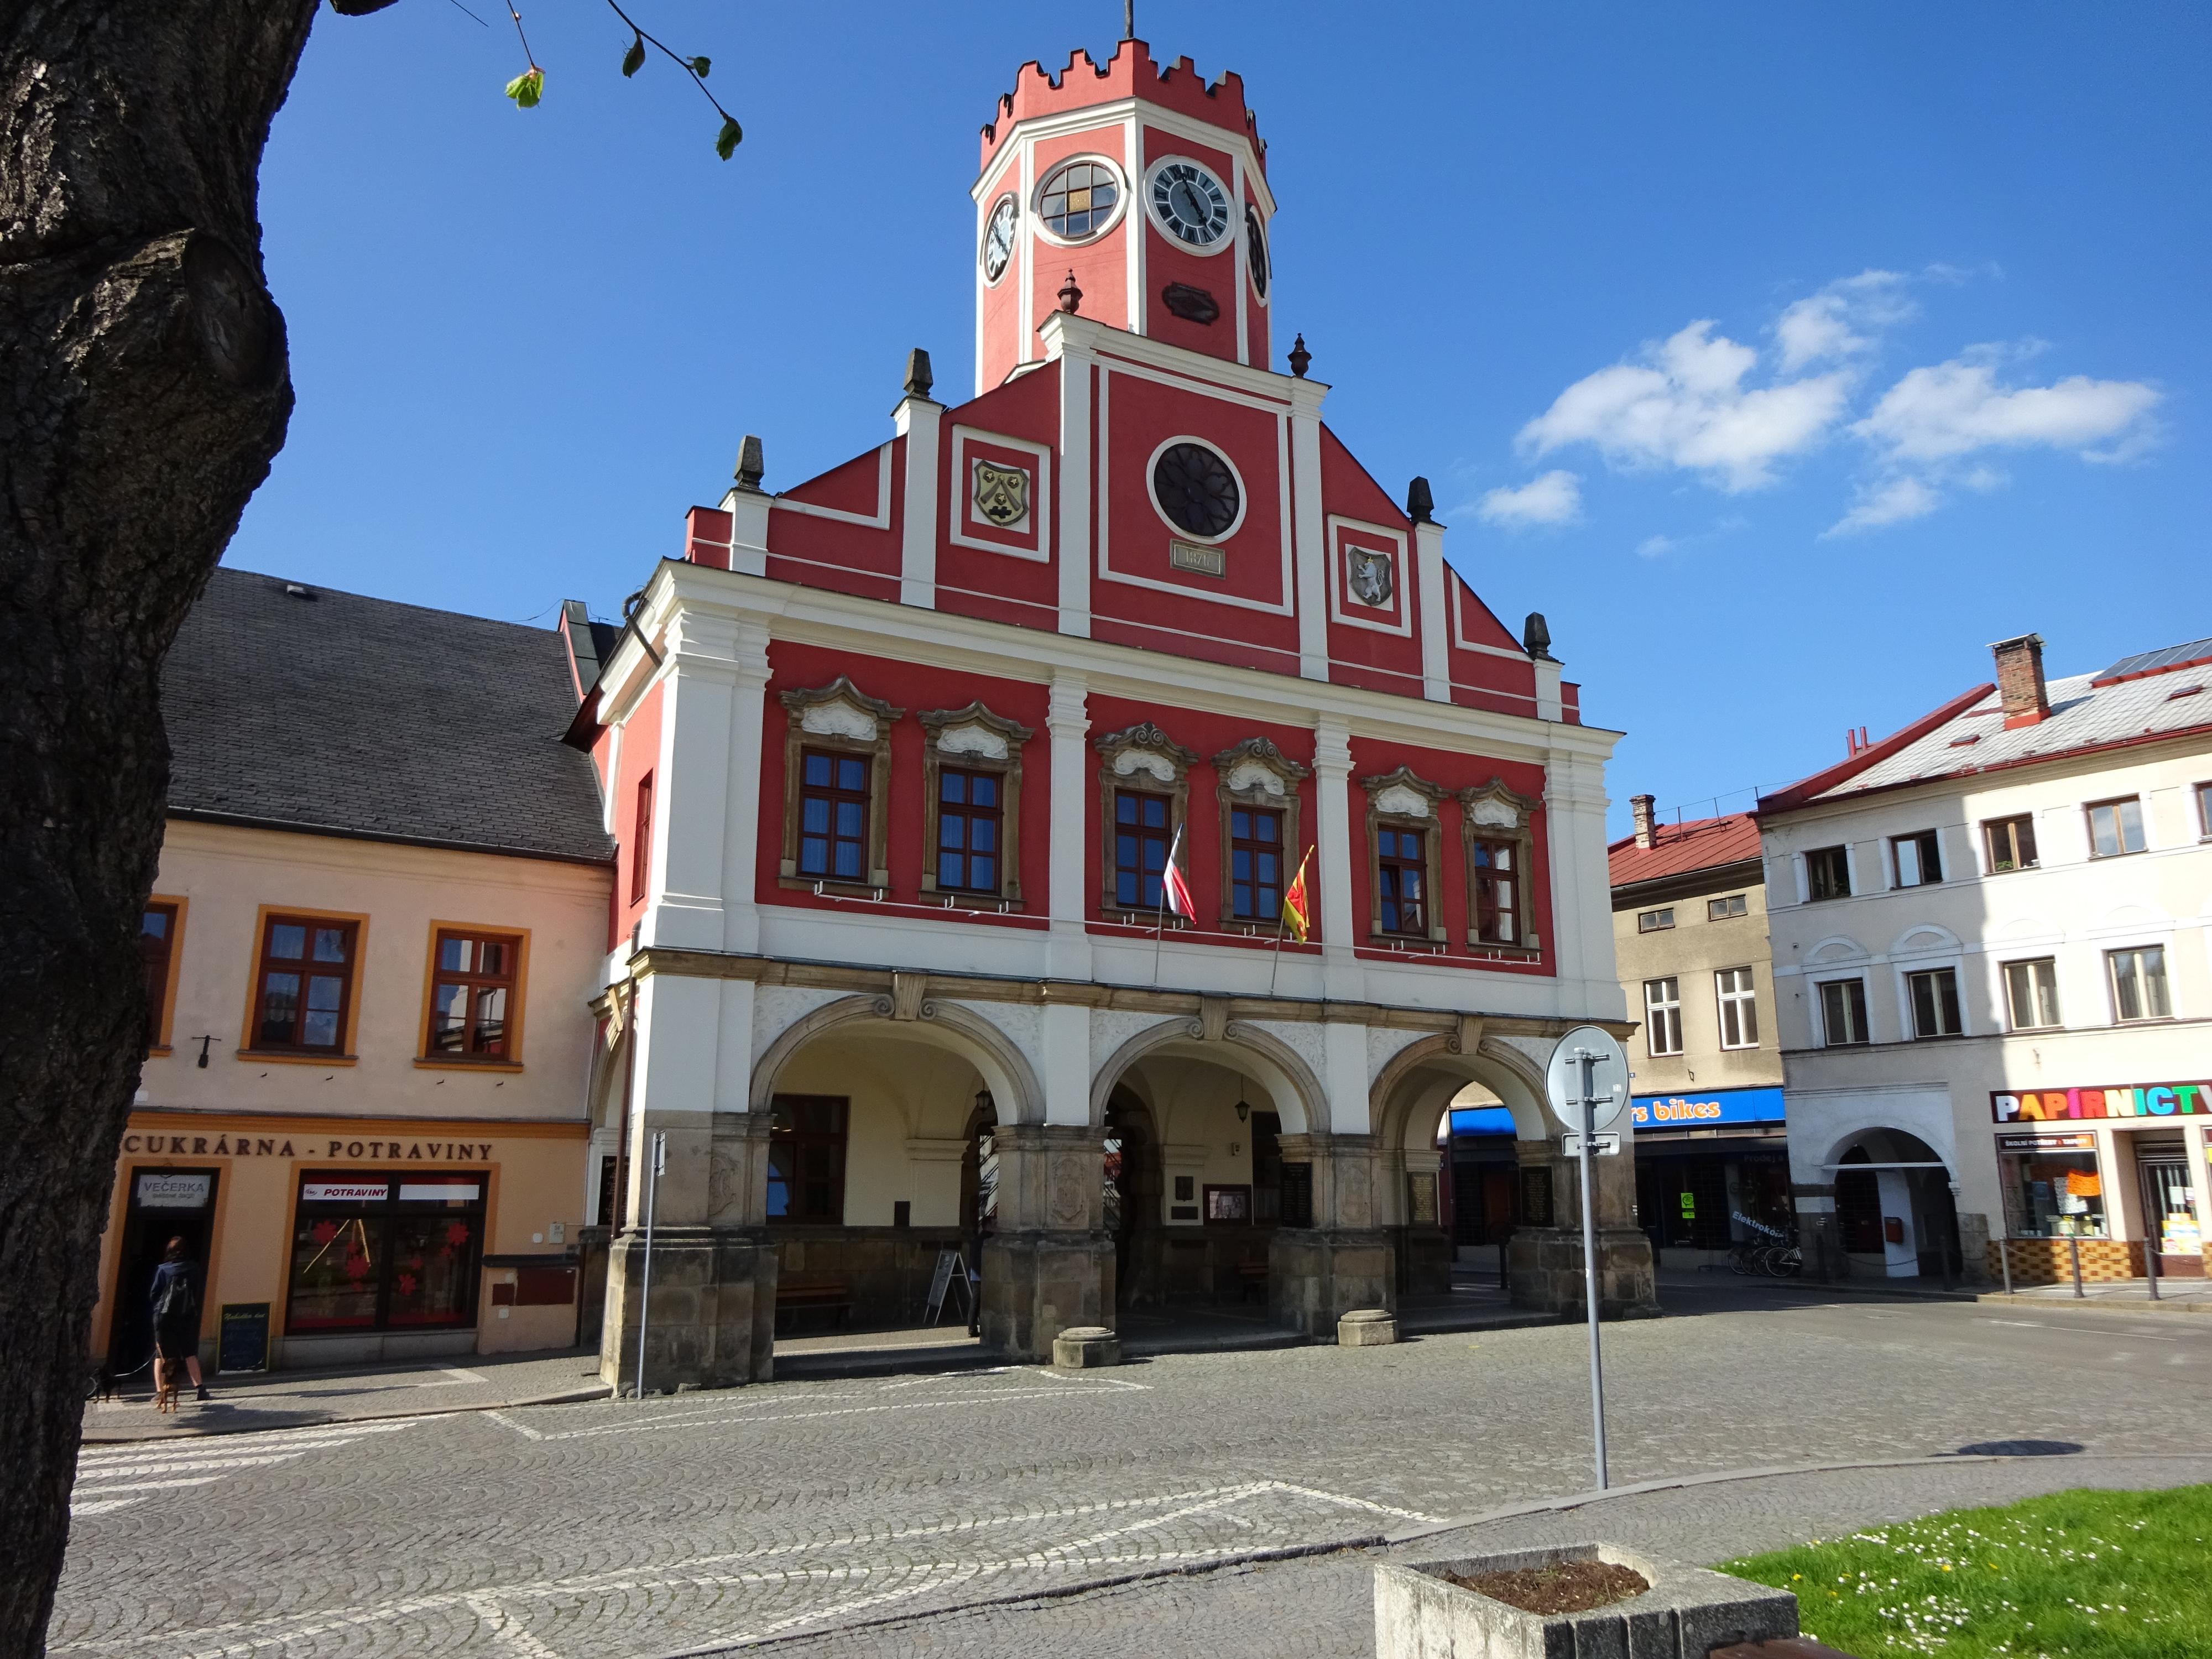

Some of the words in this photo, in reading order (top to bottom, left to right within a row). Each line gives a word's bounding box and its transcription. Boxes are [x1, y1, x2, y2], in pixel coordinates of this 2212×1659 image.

[1653, 1098, 1720, 1120] bikes
[124, 1134, 295, 1156] CUKRÁRNA
[328, 1141, 492, 1160] POTRAVINY
[144, 1181, 204, 1192] VEČERKA
[324, 1188, 387, 1197] POTRAVINY
